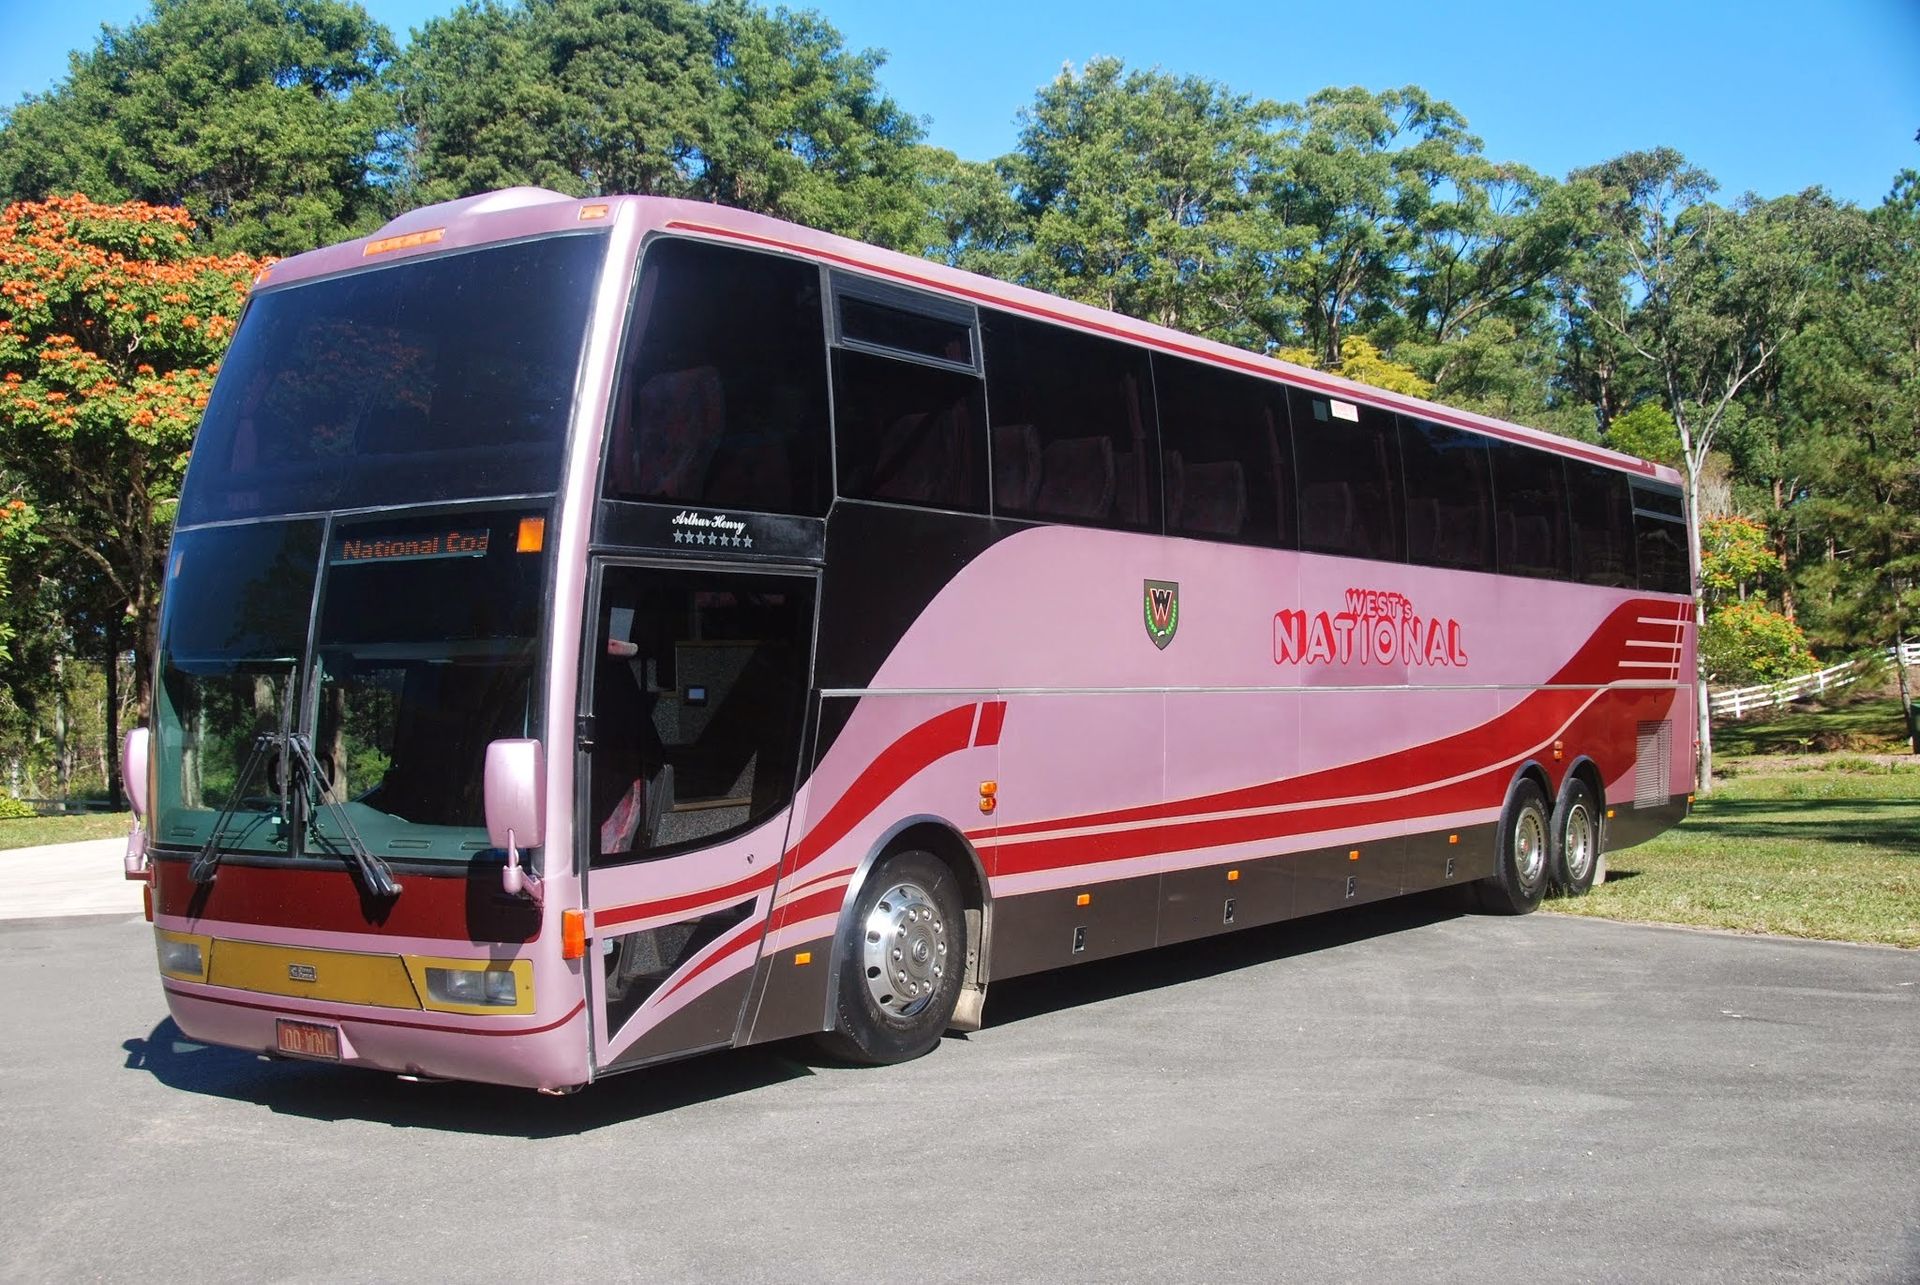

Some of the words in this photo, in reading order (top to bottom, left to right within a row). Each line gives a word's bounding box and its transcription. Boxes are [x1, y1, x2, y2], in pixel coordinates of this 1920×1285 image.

[672, 510, 711, 527] Arthur
[711, 514, 746, 535] Henry
[343, 537, 439, 560] National
[1149, 588, 1174, 625] W
[1273, 608, 1468, 666] NATIONAL
